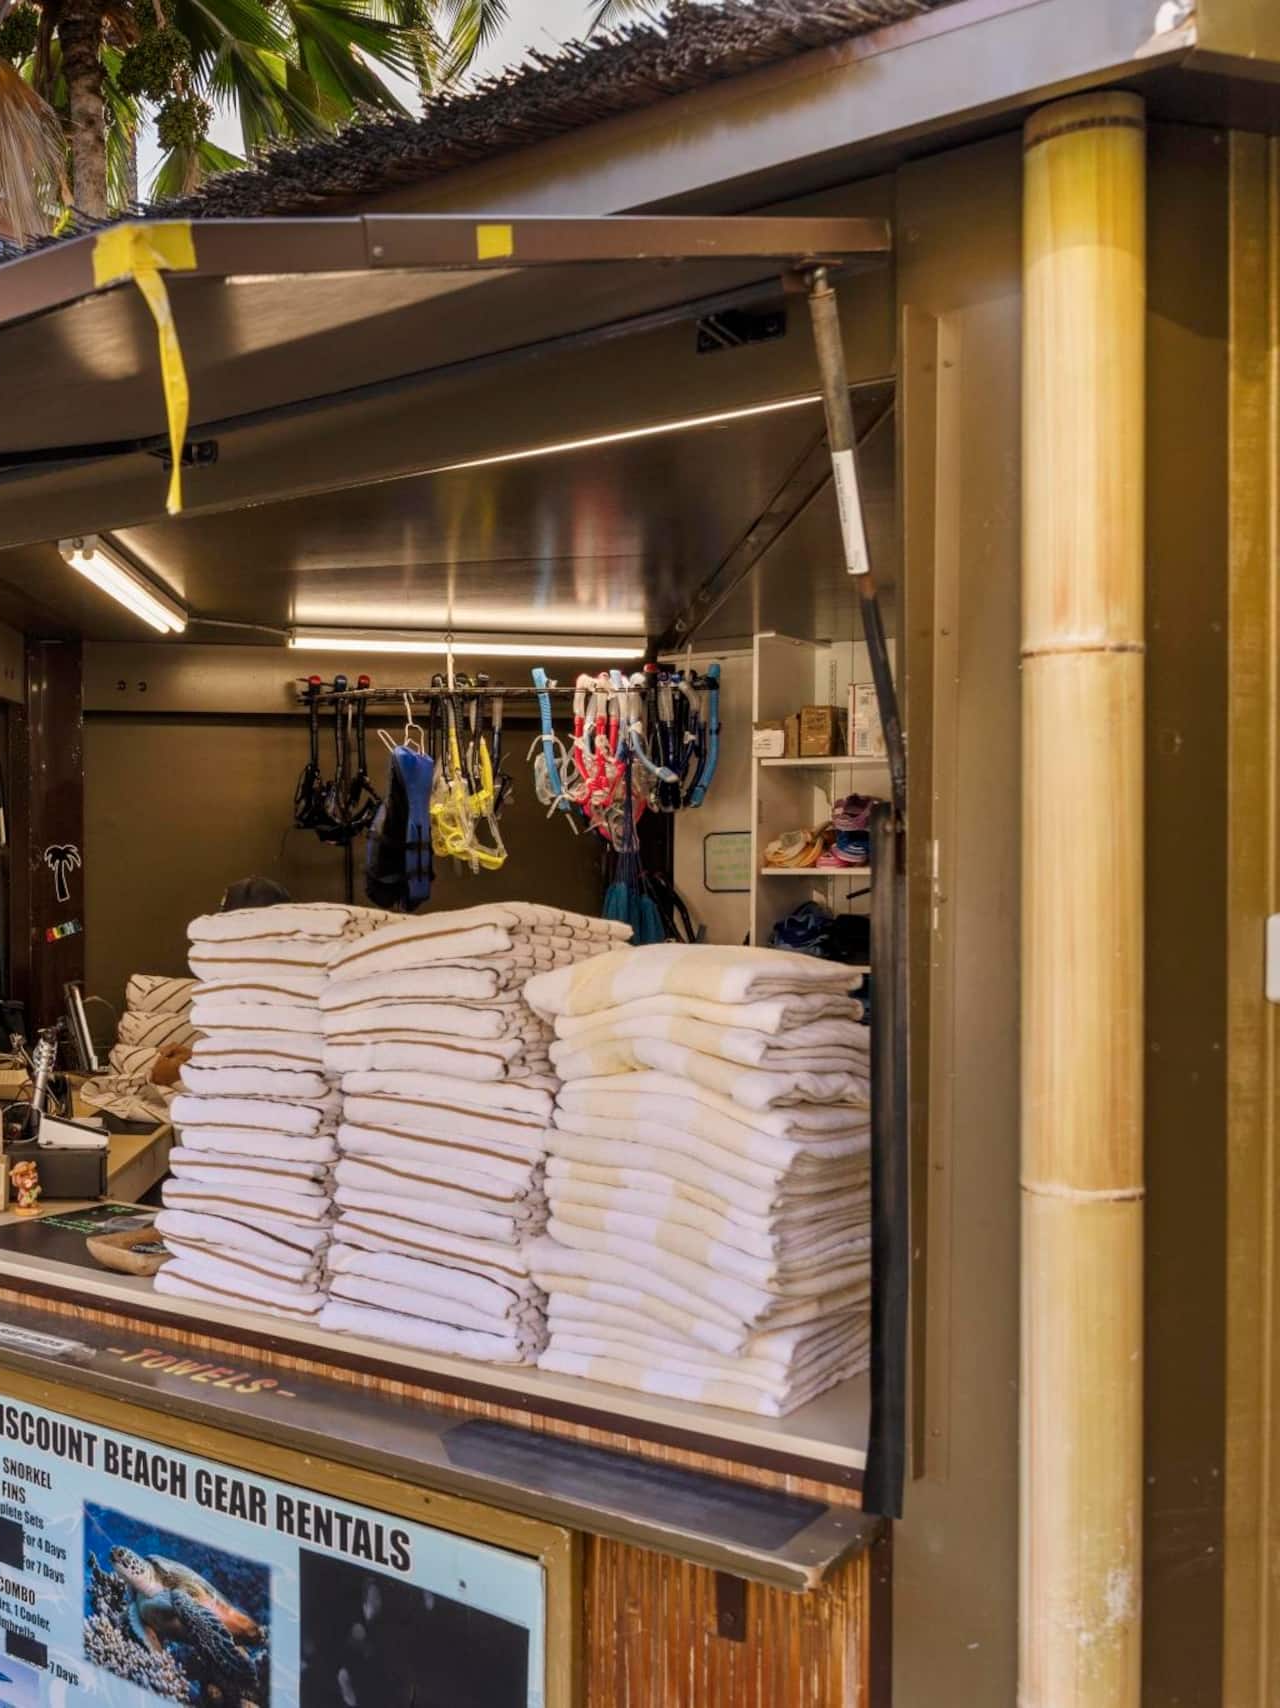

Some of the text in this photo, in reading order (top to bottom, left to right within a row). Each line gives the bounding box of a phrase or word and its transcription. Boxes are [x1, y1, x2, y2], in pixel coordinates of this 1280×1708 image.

[2, 1456, 53, 1490] SNORKEL
[1, 1479, 27, 1504] FINS
[103, 1438, 188, 1500] BEACH
[195, 1468, 267, 1527] GEAR
[275, 1493, 412, 1572] RENTALS
[24, 1511, 44, 1530] Sets
[36, 1537, 43, 1550] 4
[44, 1539, 66, 1560] Days
[36, 1560, 41, 1574] 7
[43, 1562, 65, 1584] Days
[14, 1604, 19, 1617] 1
[56, 1663, 79, 1686] Days
